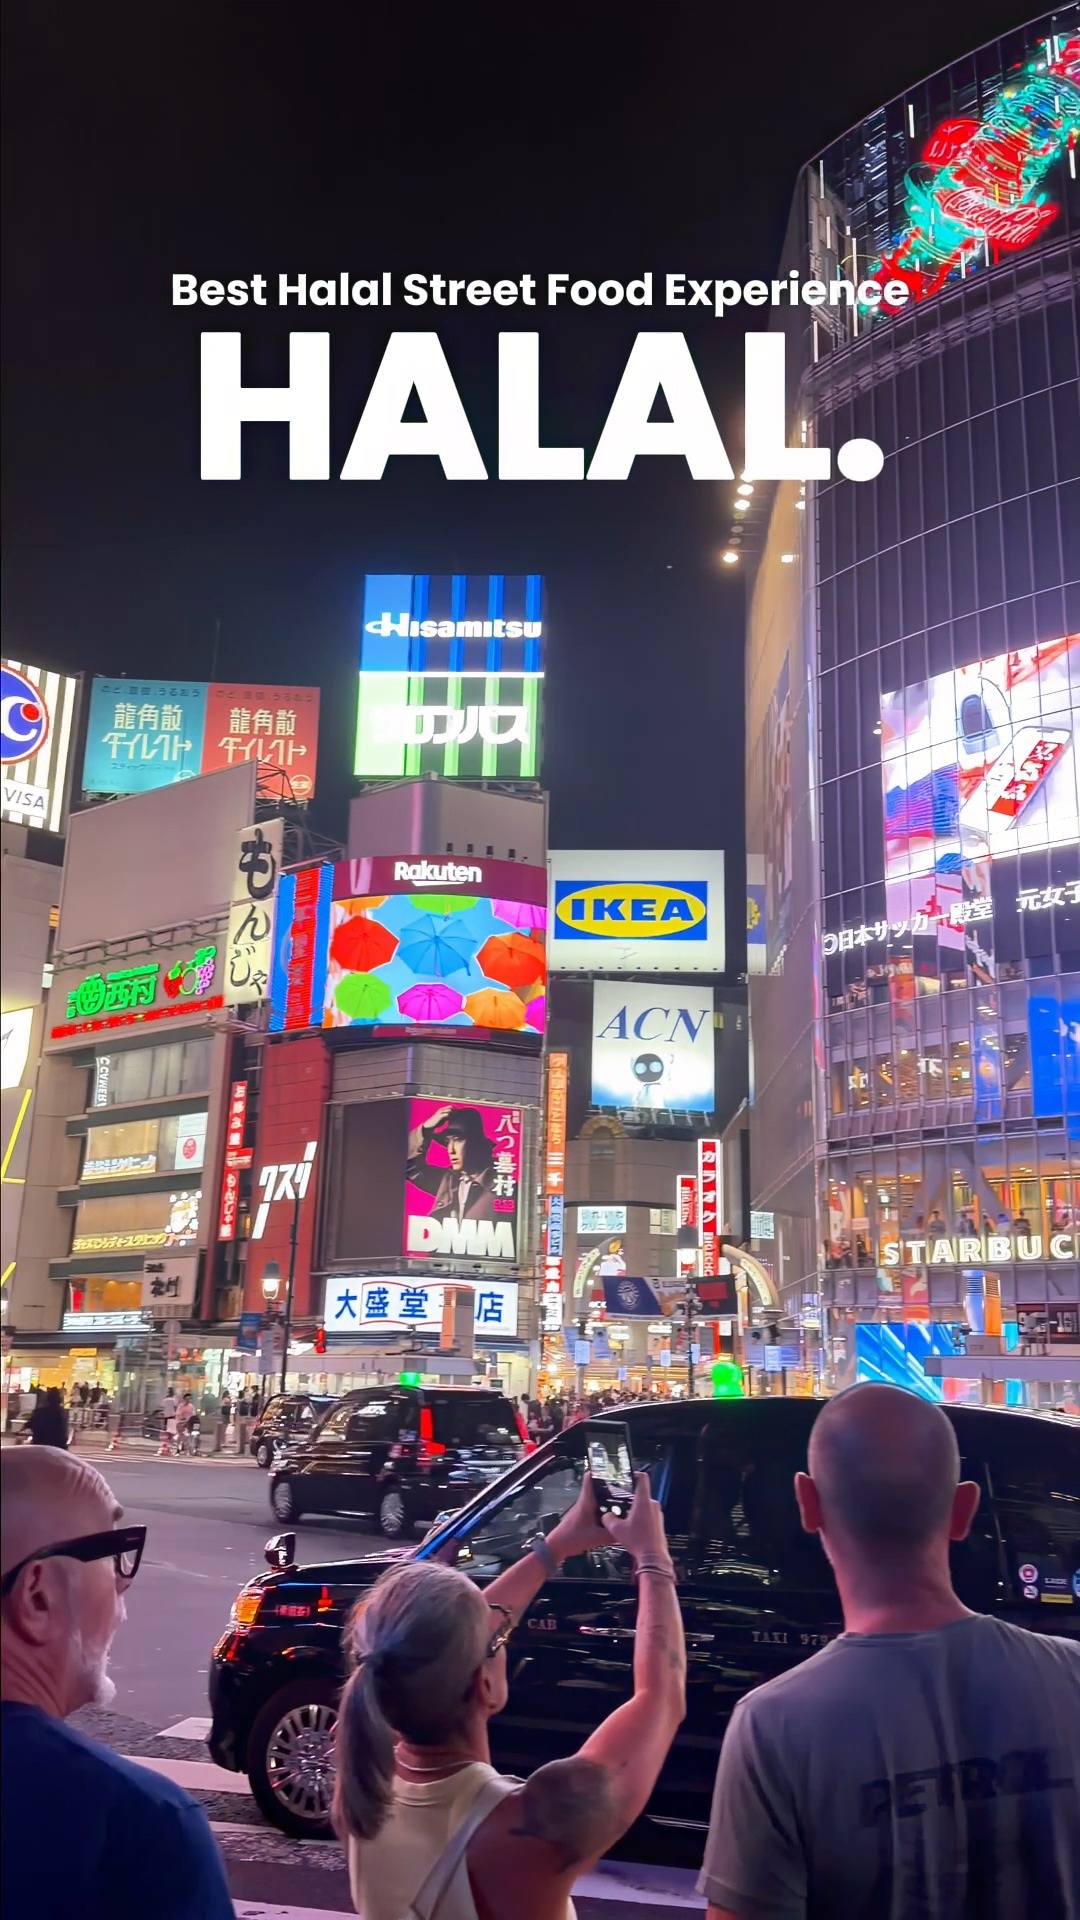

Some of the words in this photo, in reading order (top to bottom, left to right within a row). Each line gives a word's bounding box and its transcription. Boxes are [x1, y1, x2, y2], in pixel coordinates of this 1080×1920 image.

[365, 612, 542, 638] Hisamitsu
[113, 702, 183, 731] 龍角散
[229, 707, 298, 736] 龍角散
[371, 704, 529, 744] ロンパス
[102, 732, 193, 761] ダイレクト
[4, 786, 45, 810] VISA
[394, 860, 483, 883] Rakuten
[230, 828, 276, 996] もんじゃ
[570, 898, 695, 922] IKEA
[595, 1005, 711, 1043] ACN
[251, 1141, 318, 1239] クスリ
[702, 1151, 717, 1224] カラオケ
[406, 1214, 516, 1258] DMM
[883, 1234, 1074, 1265] STARBUC
[335, 1286, 504, 1323] 大盛堂店
[527, 1618, 558, 1631] CAB
[752, 1630, 788, 1645] TAXI
